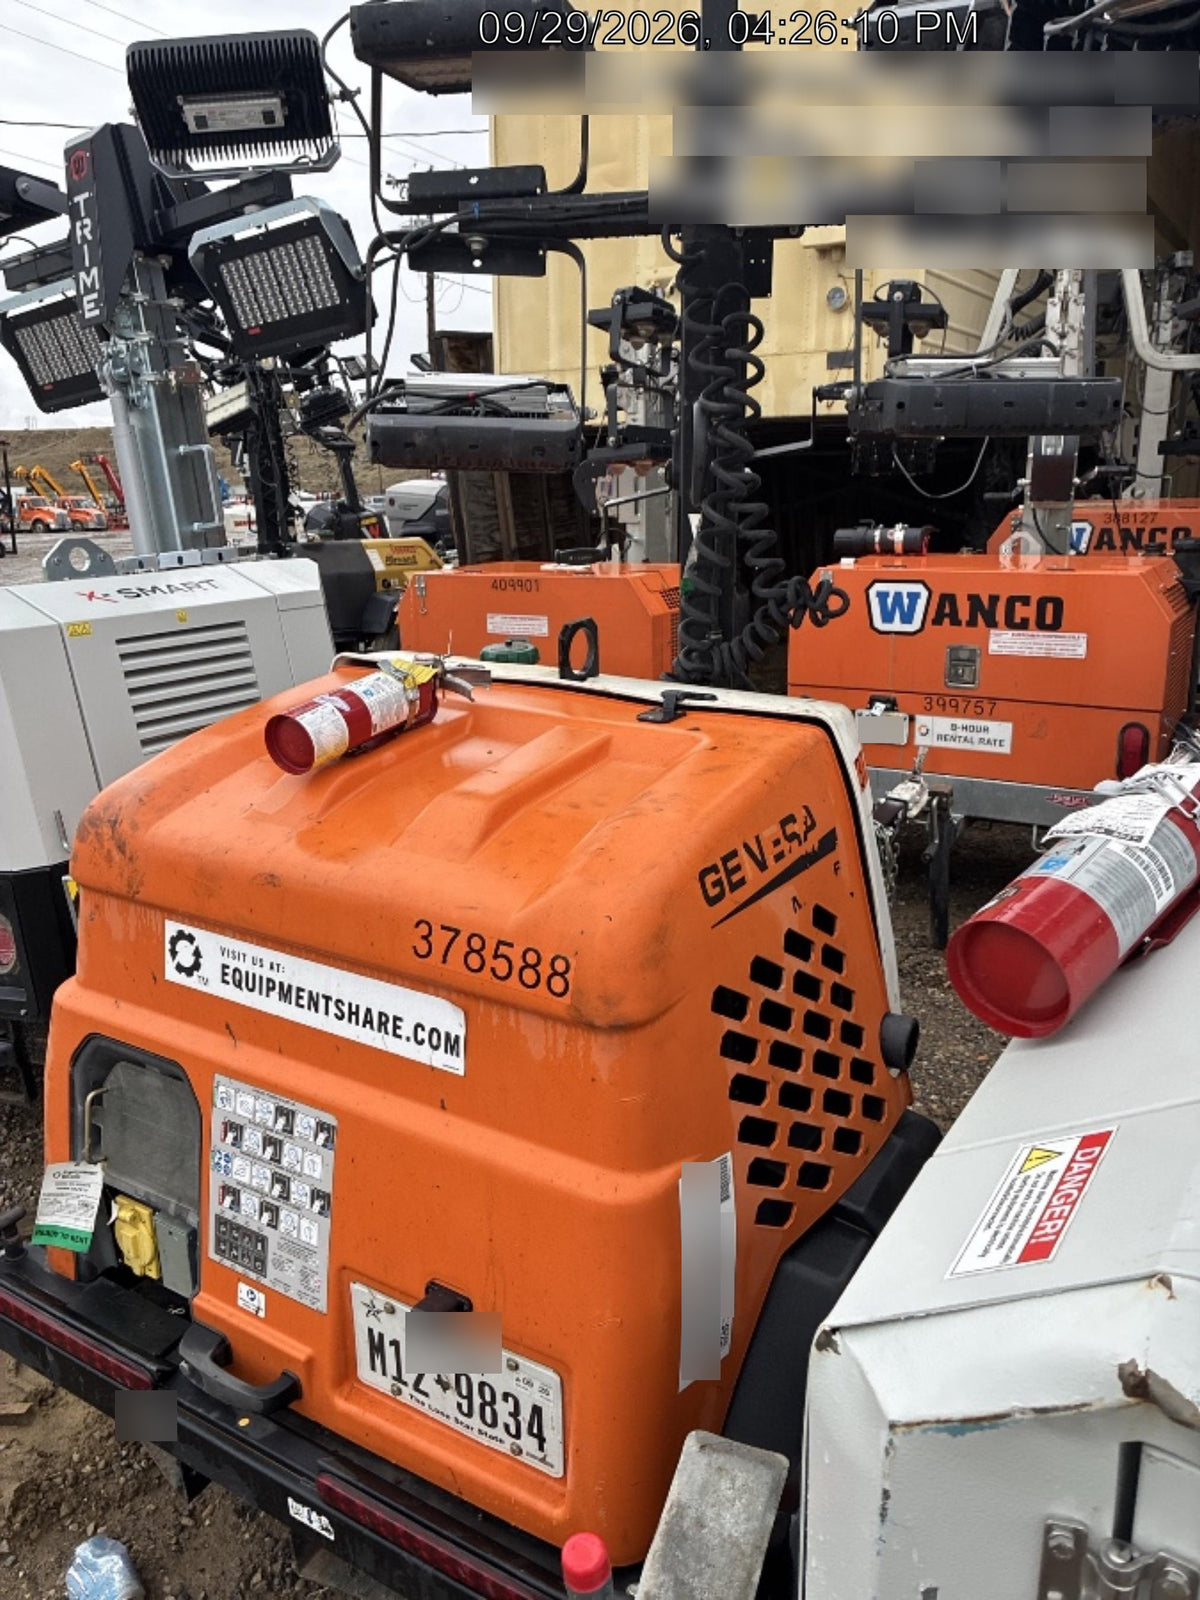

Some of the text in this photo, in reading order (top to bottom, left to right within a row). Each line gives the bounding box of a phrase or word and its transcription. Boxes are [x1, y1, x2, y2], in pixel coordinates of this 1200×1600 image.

[73, 191, 101, 320] TRIME
[491, 578, 540, 593] 409901
[872, 588, 1064, 632] WANCO
[923, 696, 998, 718] 399757
[936, 734, 1006, 748] RENTAL RATE
[219, 945, 286, 974] VISIT US AT:
[412, 918, 571, 998] 378588
[219, 963, 461, 1059] EQUIPMENTSHARE.COM
[1029, 1146, 1104, 1244] DANGER!
[408, 1393, 426, 1407] The
[454, 1416, 474, 1432] Star
[477, 1428, 506, 1445] State
[454, 1373, 547, 1453] 9834
